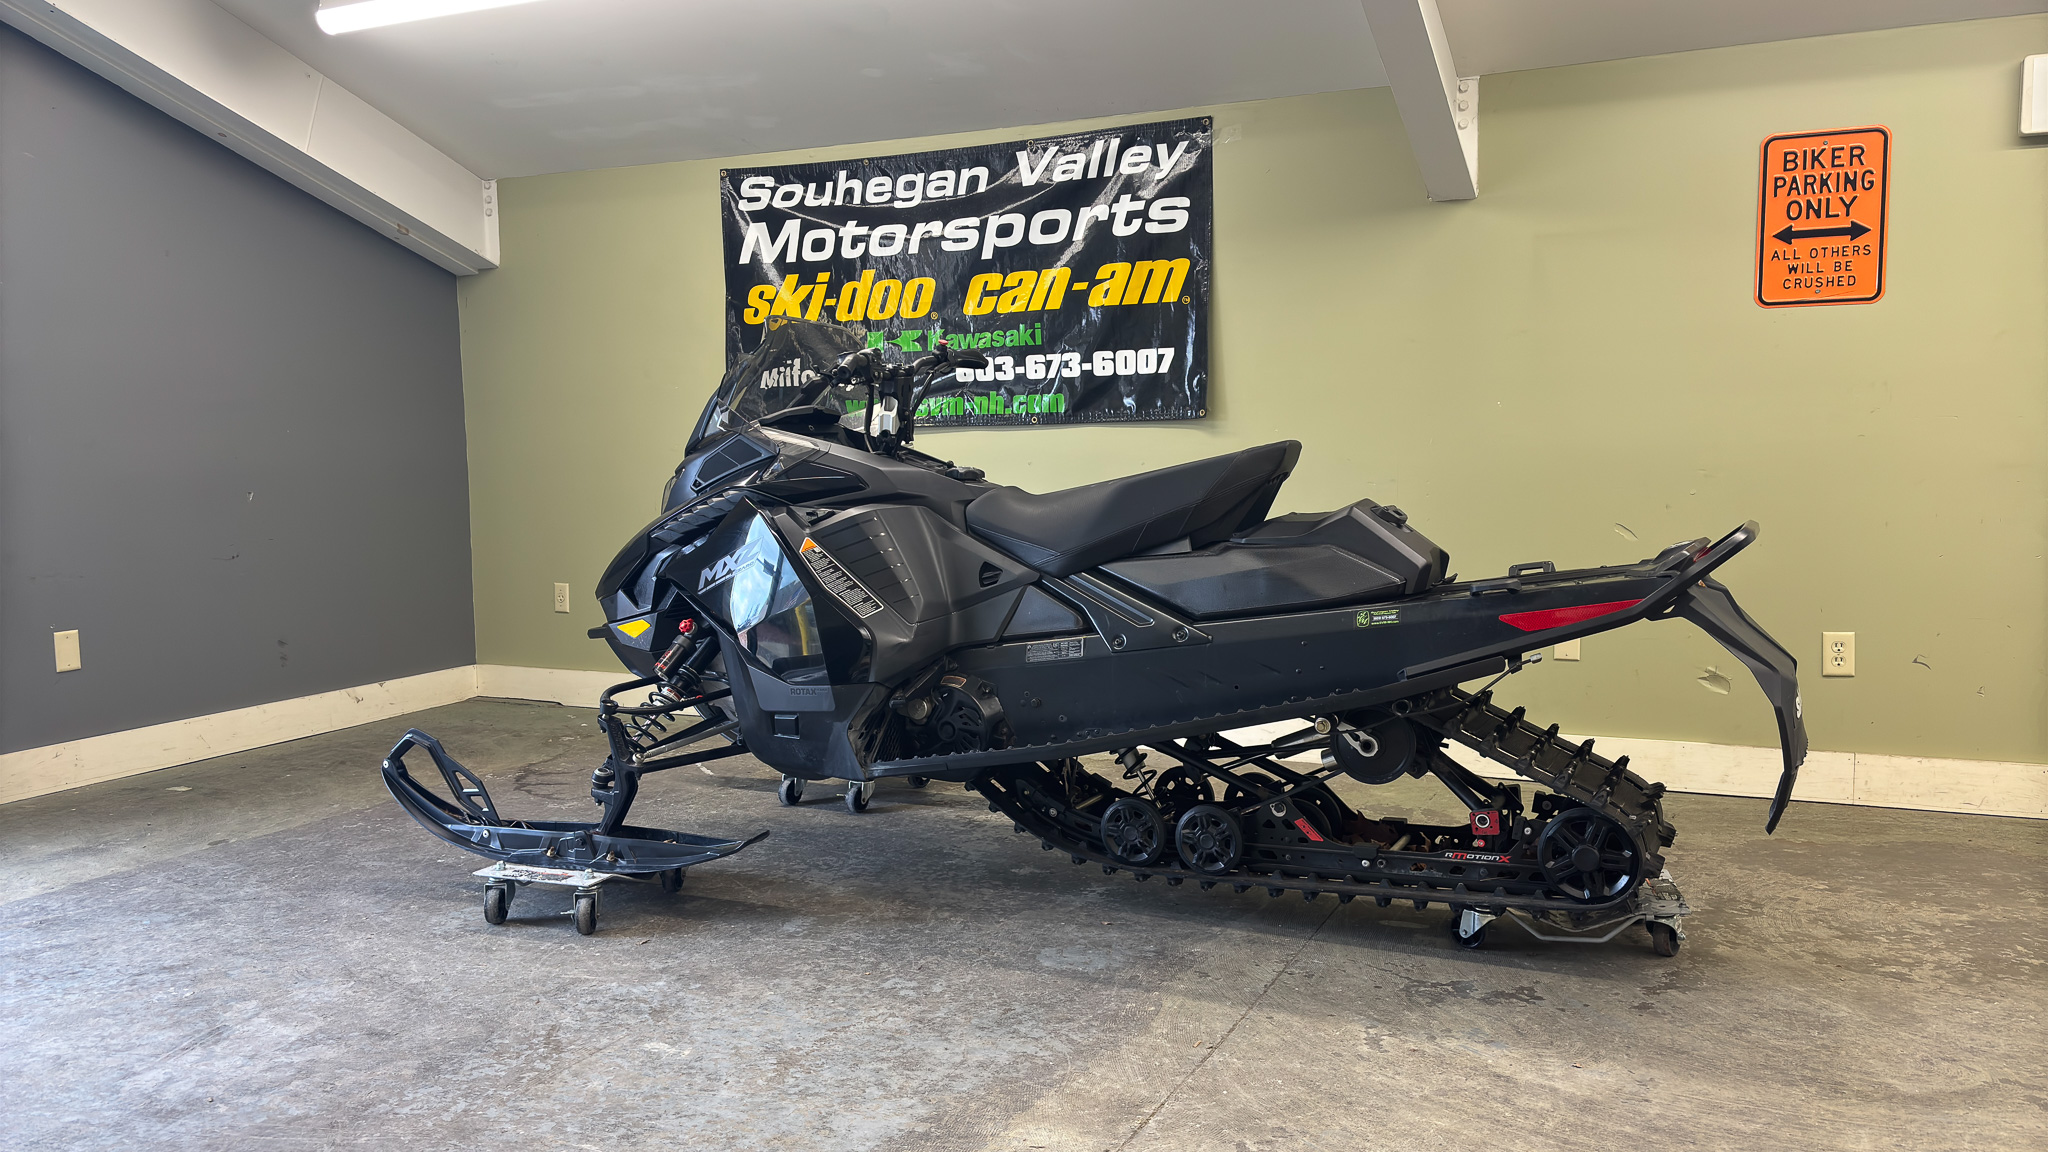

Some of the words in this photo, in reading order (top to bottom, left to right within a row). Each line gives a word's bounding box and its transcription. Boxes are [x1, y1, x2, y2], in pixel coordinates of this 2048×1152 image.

[1783, 145, 1866, 172] BIKER
[739, 162, 989, 212] Souhegan
[1015, 138, 1189, 187] Valley
[1773, 169, 1876, 197] PARKING
[1786, 195, 1858, 221] ONLY
[739, 193, 1190, 265] Motorsports
[1771, 248, 1801, 261] ALL
[1810, 245, 1872, 258] OTHERS
[1788, 262, 1824, 274] WILL
[1834, 260, 1853, 272] BE
[743, 269, 936, 326] ski-doo
[962, 258, 1191, 316] can-am
[1783, 275, 1857, 289] CRUSHED
[927, 323, 1042, 351] Kawasaki
[760, 357, 817, 389] Milfo
[698, 538, 762, 591] MXZ
[790, 688, 817, 696] ROTAX
